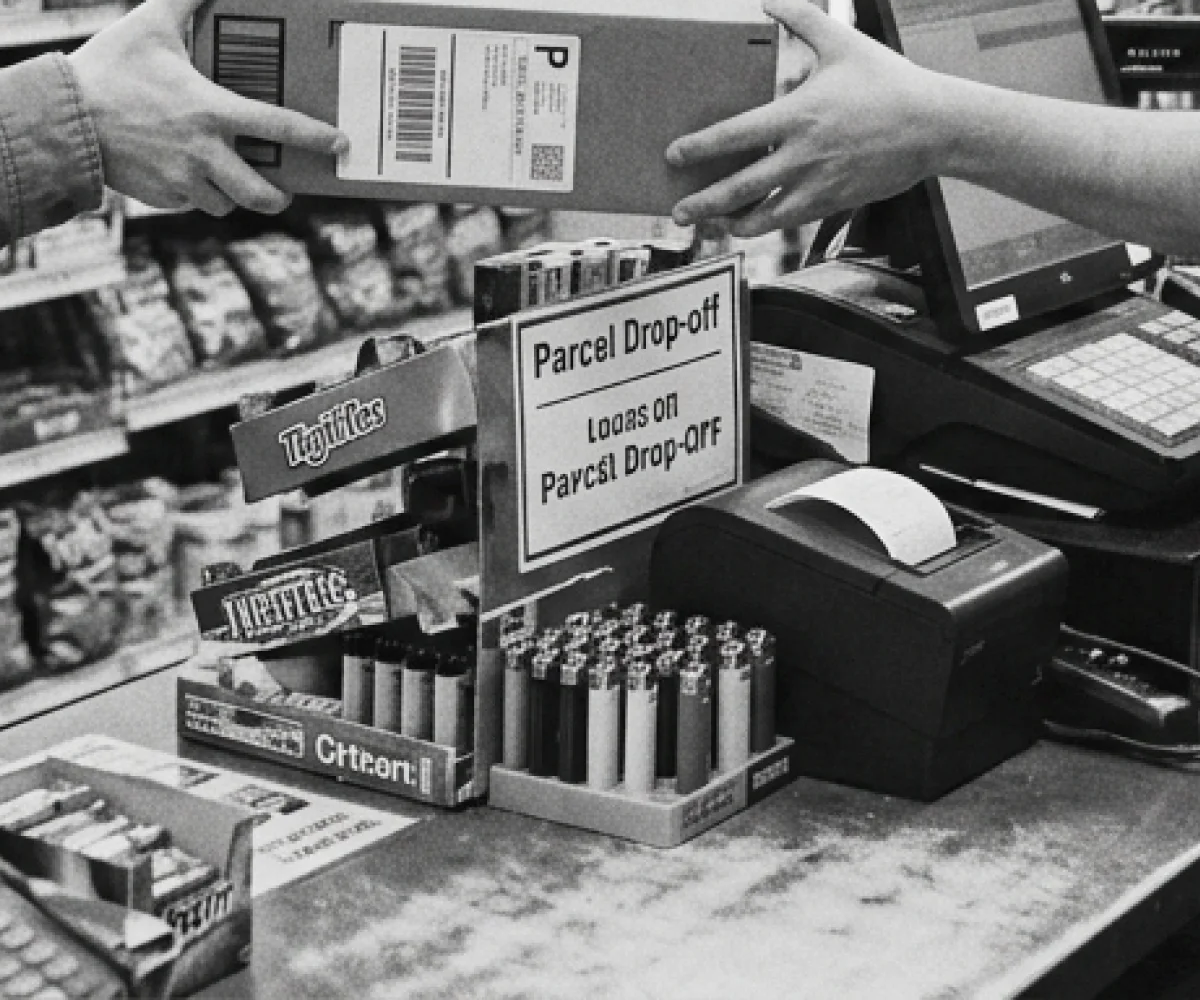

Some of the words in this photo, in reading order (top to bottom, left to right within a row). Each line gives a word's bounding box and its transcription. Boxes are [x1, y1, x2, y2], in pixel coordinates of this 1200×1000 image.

[534, 46, 569, 69] P
[533, 324, 616, 379] Parcel
[624, 291, 720, 355] Drop-off
[653, 391, 678, 423] on
